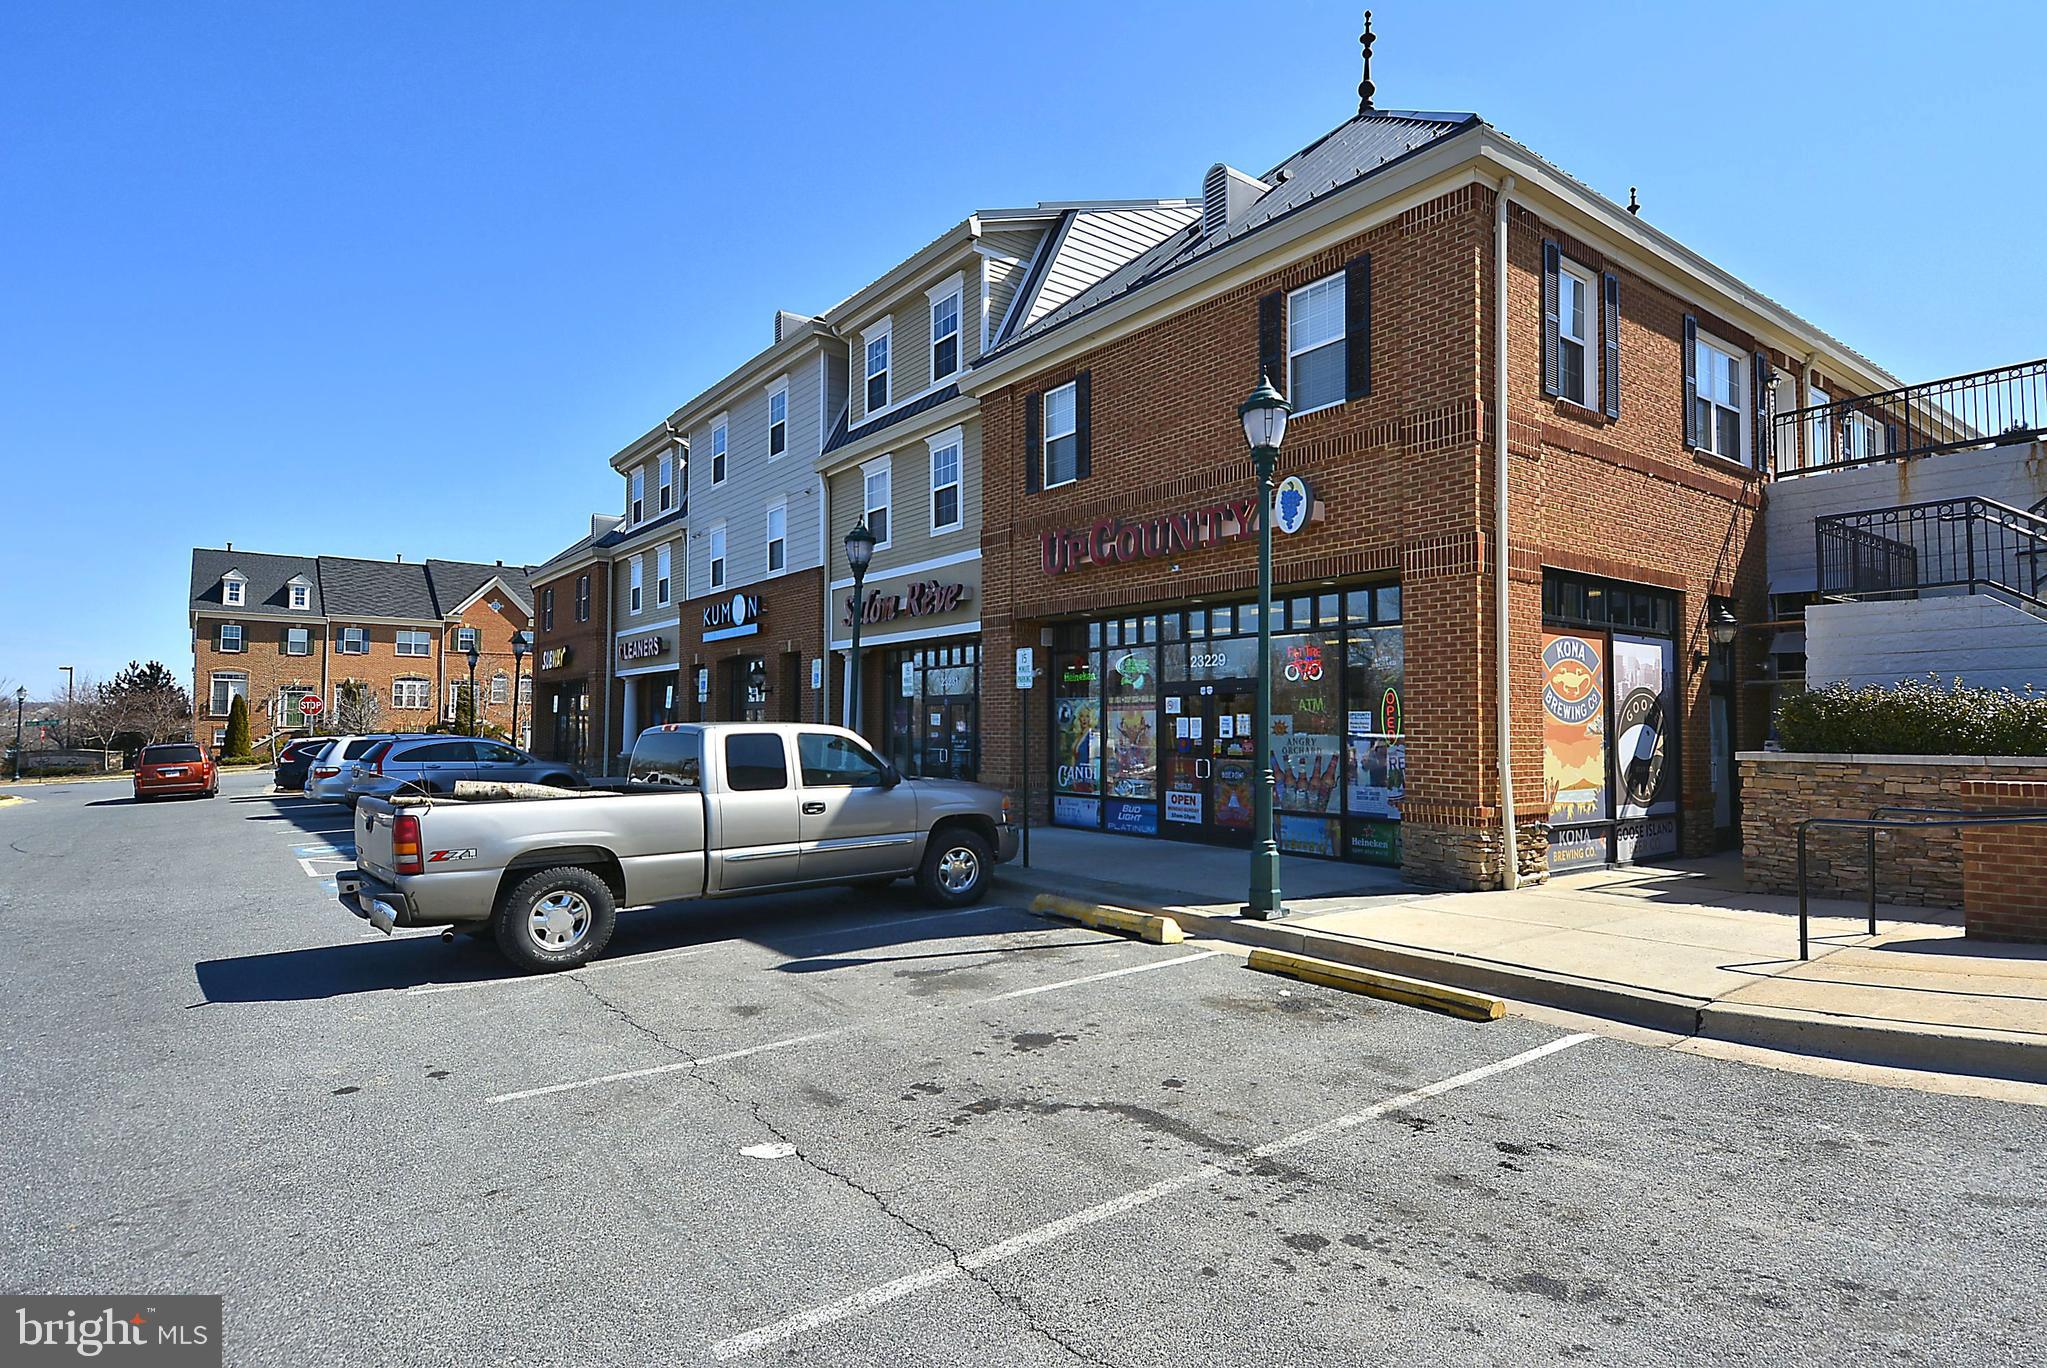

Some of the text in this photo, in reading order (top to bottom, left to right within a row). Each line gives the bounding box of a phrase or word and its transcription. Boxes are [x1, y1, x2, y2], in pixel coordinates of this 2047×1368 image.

[904, 580, 963, 617] Rêve
[703, 593, 758, 627] KUMON
[618, 636, 660, 660] CLEANERS
[1556, 640, 1586, 660] KONA
[542, 646, 566, 670] SUBWAY
[1190, 653, 1226, 668] 23229
[1063, 671, 1097, 682] Heineken
[300, 700, 322, 710] STOP
[1299, 697, 1326, 712] ATM
[1545, 689, 1588, 721] BREWING
[1288, 737, 1317, 747] ANGRY
[1171, 794, 1196, 806] OPEN
[1122, 804, 1141, 813] BUD
[1118, 812, 1142, 822] LIGHT
[1107, 822, 1156, 834] PLATINUM
[1616, 822, 1673, 841] GOOSE ISLAND
[1351, 837, 1389, 849] Heineken
[1558, 828, 1592, 847] KONA
[428, 848, 478, 862] Z71
[1553, 847, 1597, 862] BREWING CO.
